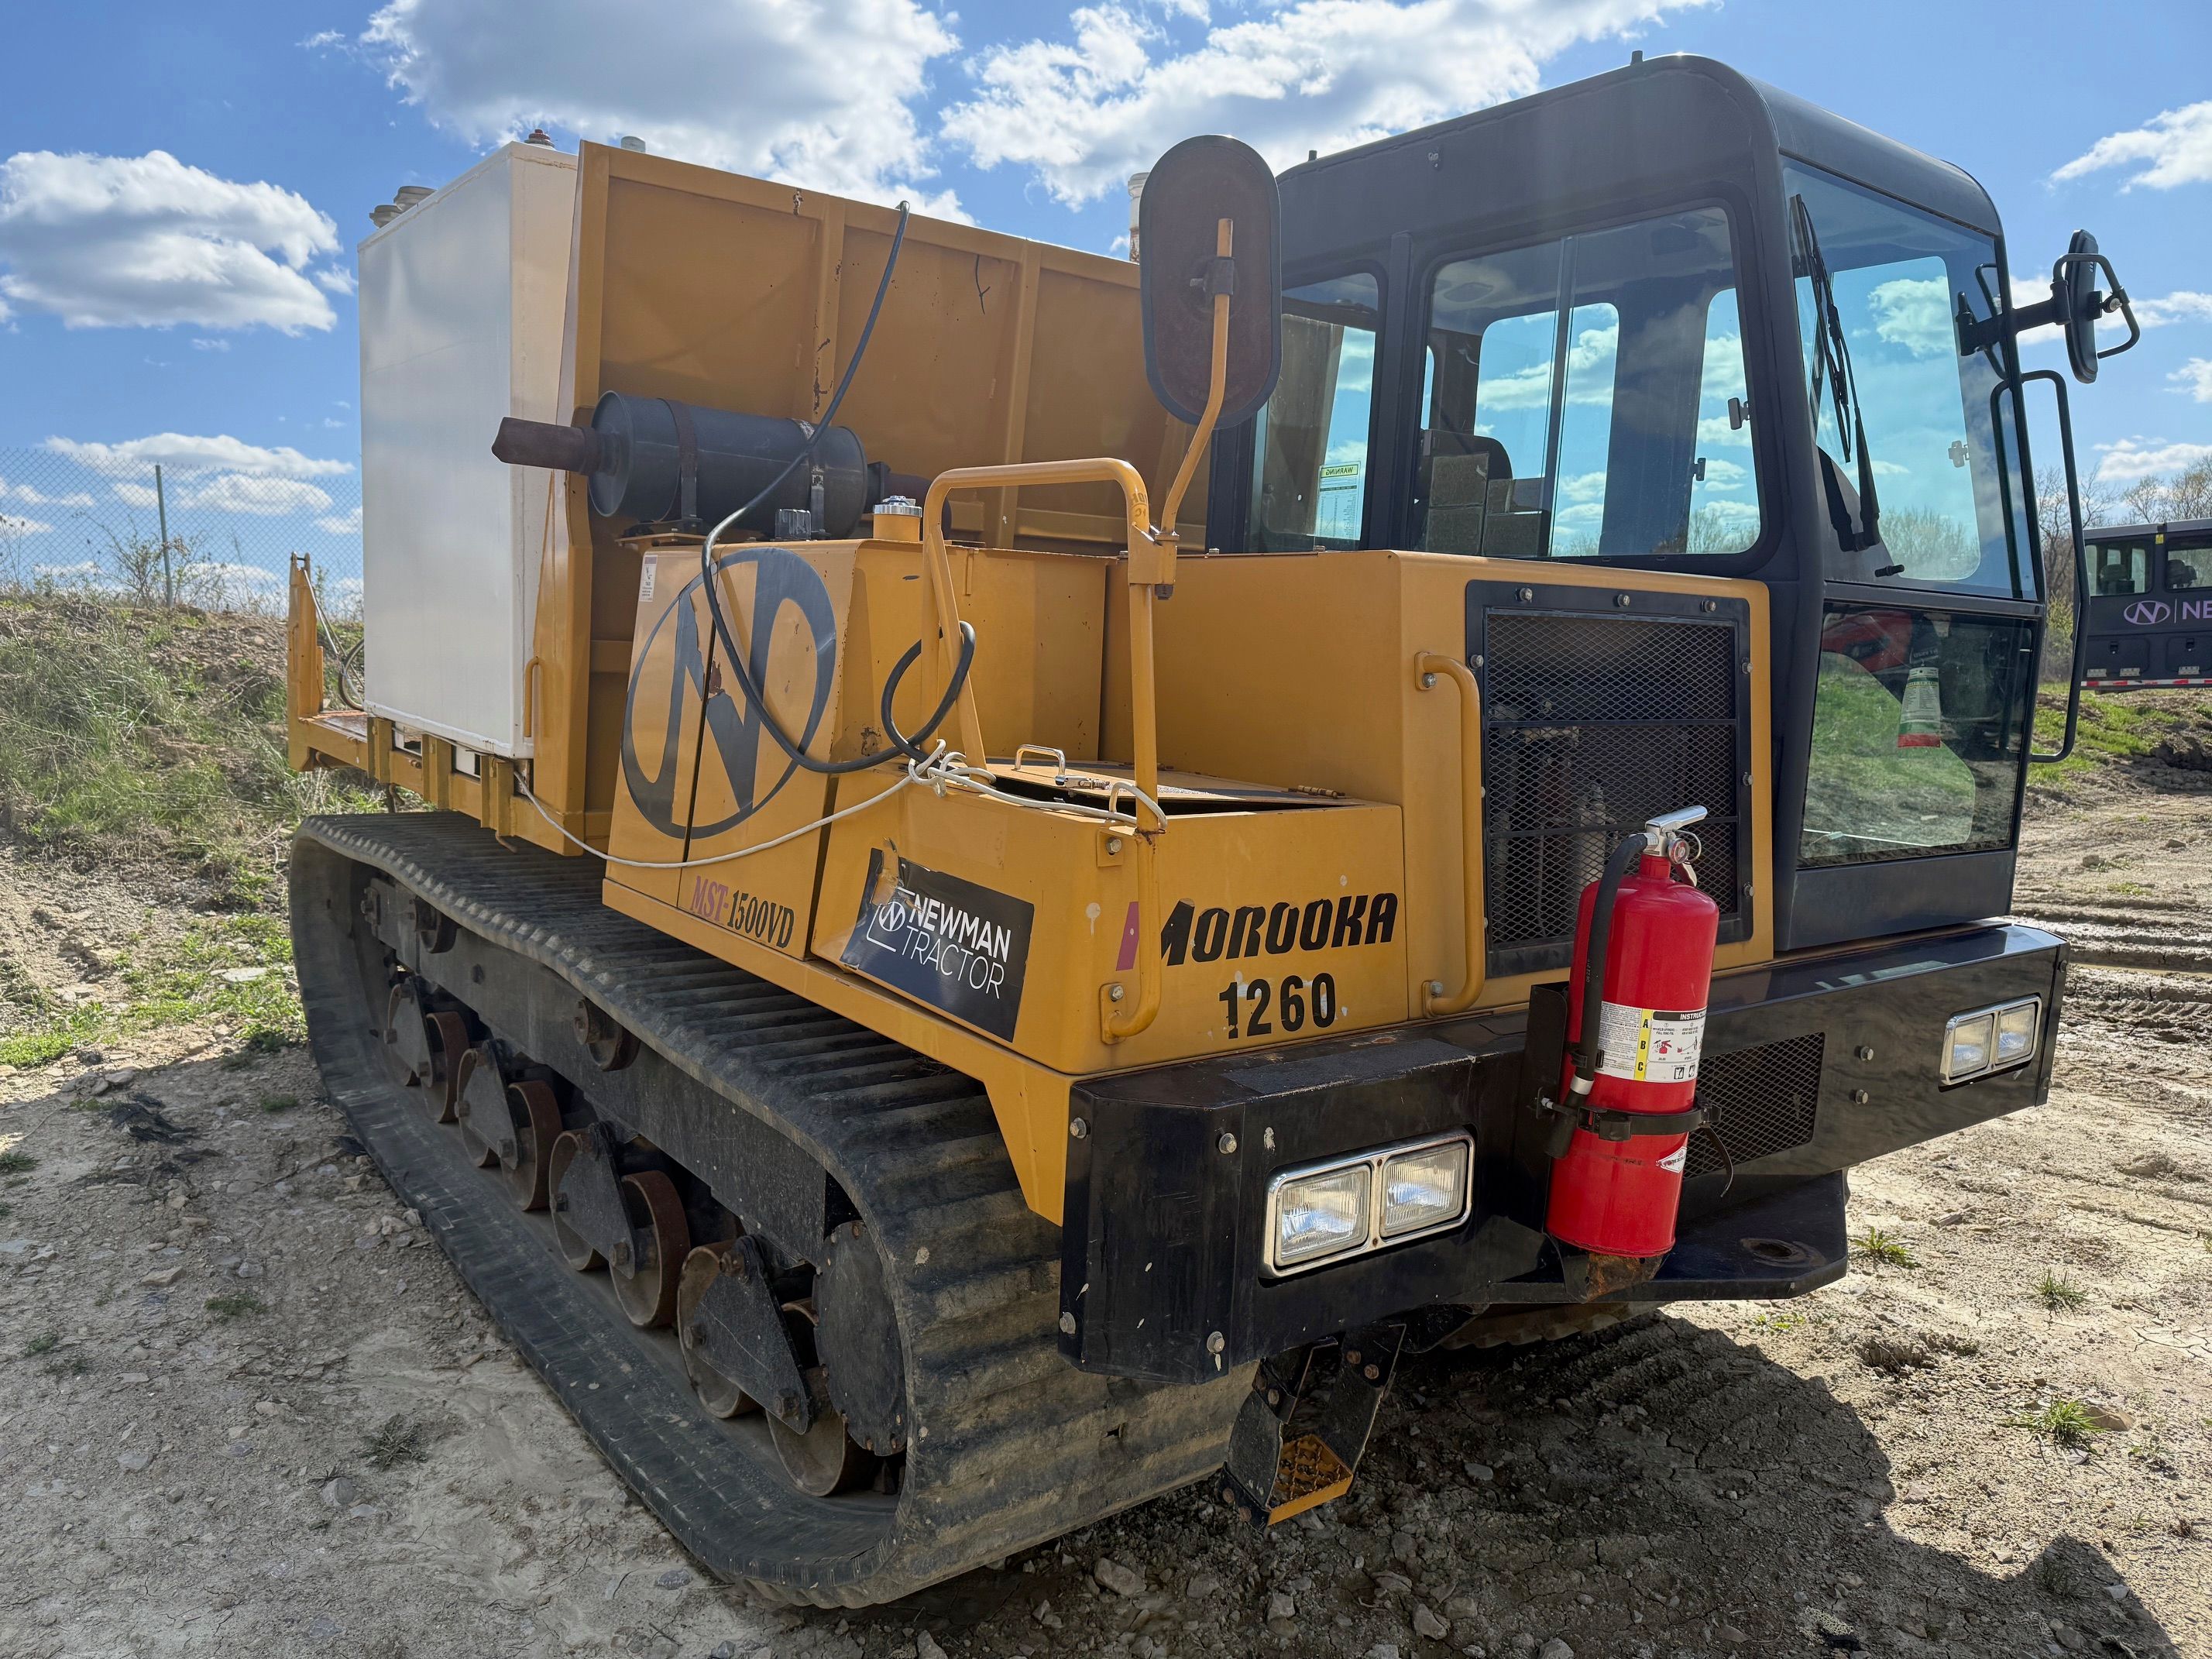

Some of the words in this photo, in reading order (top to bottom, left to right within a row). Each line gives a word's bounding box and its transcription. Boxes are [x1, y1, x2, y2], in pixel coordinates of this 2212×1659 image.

[689, 874, 795, 949] MST-1500VD
[908, 893, 1012, 963] NEWMAN
[1115, 892, 1399, 971] MOROOKA
[902, 925, 1005, 1000] TRACTOR
[1219, 973, 1336, 1039] 1260
[1643, 1019, 1648, 1028] A
[1638, 1062, 1644, 1070] C
[1640, 1040, 1646, 1049] B
